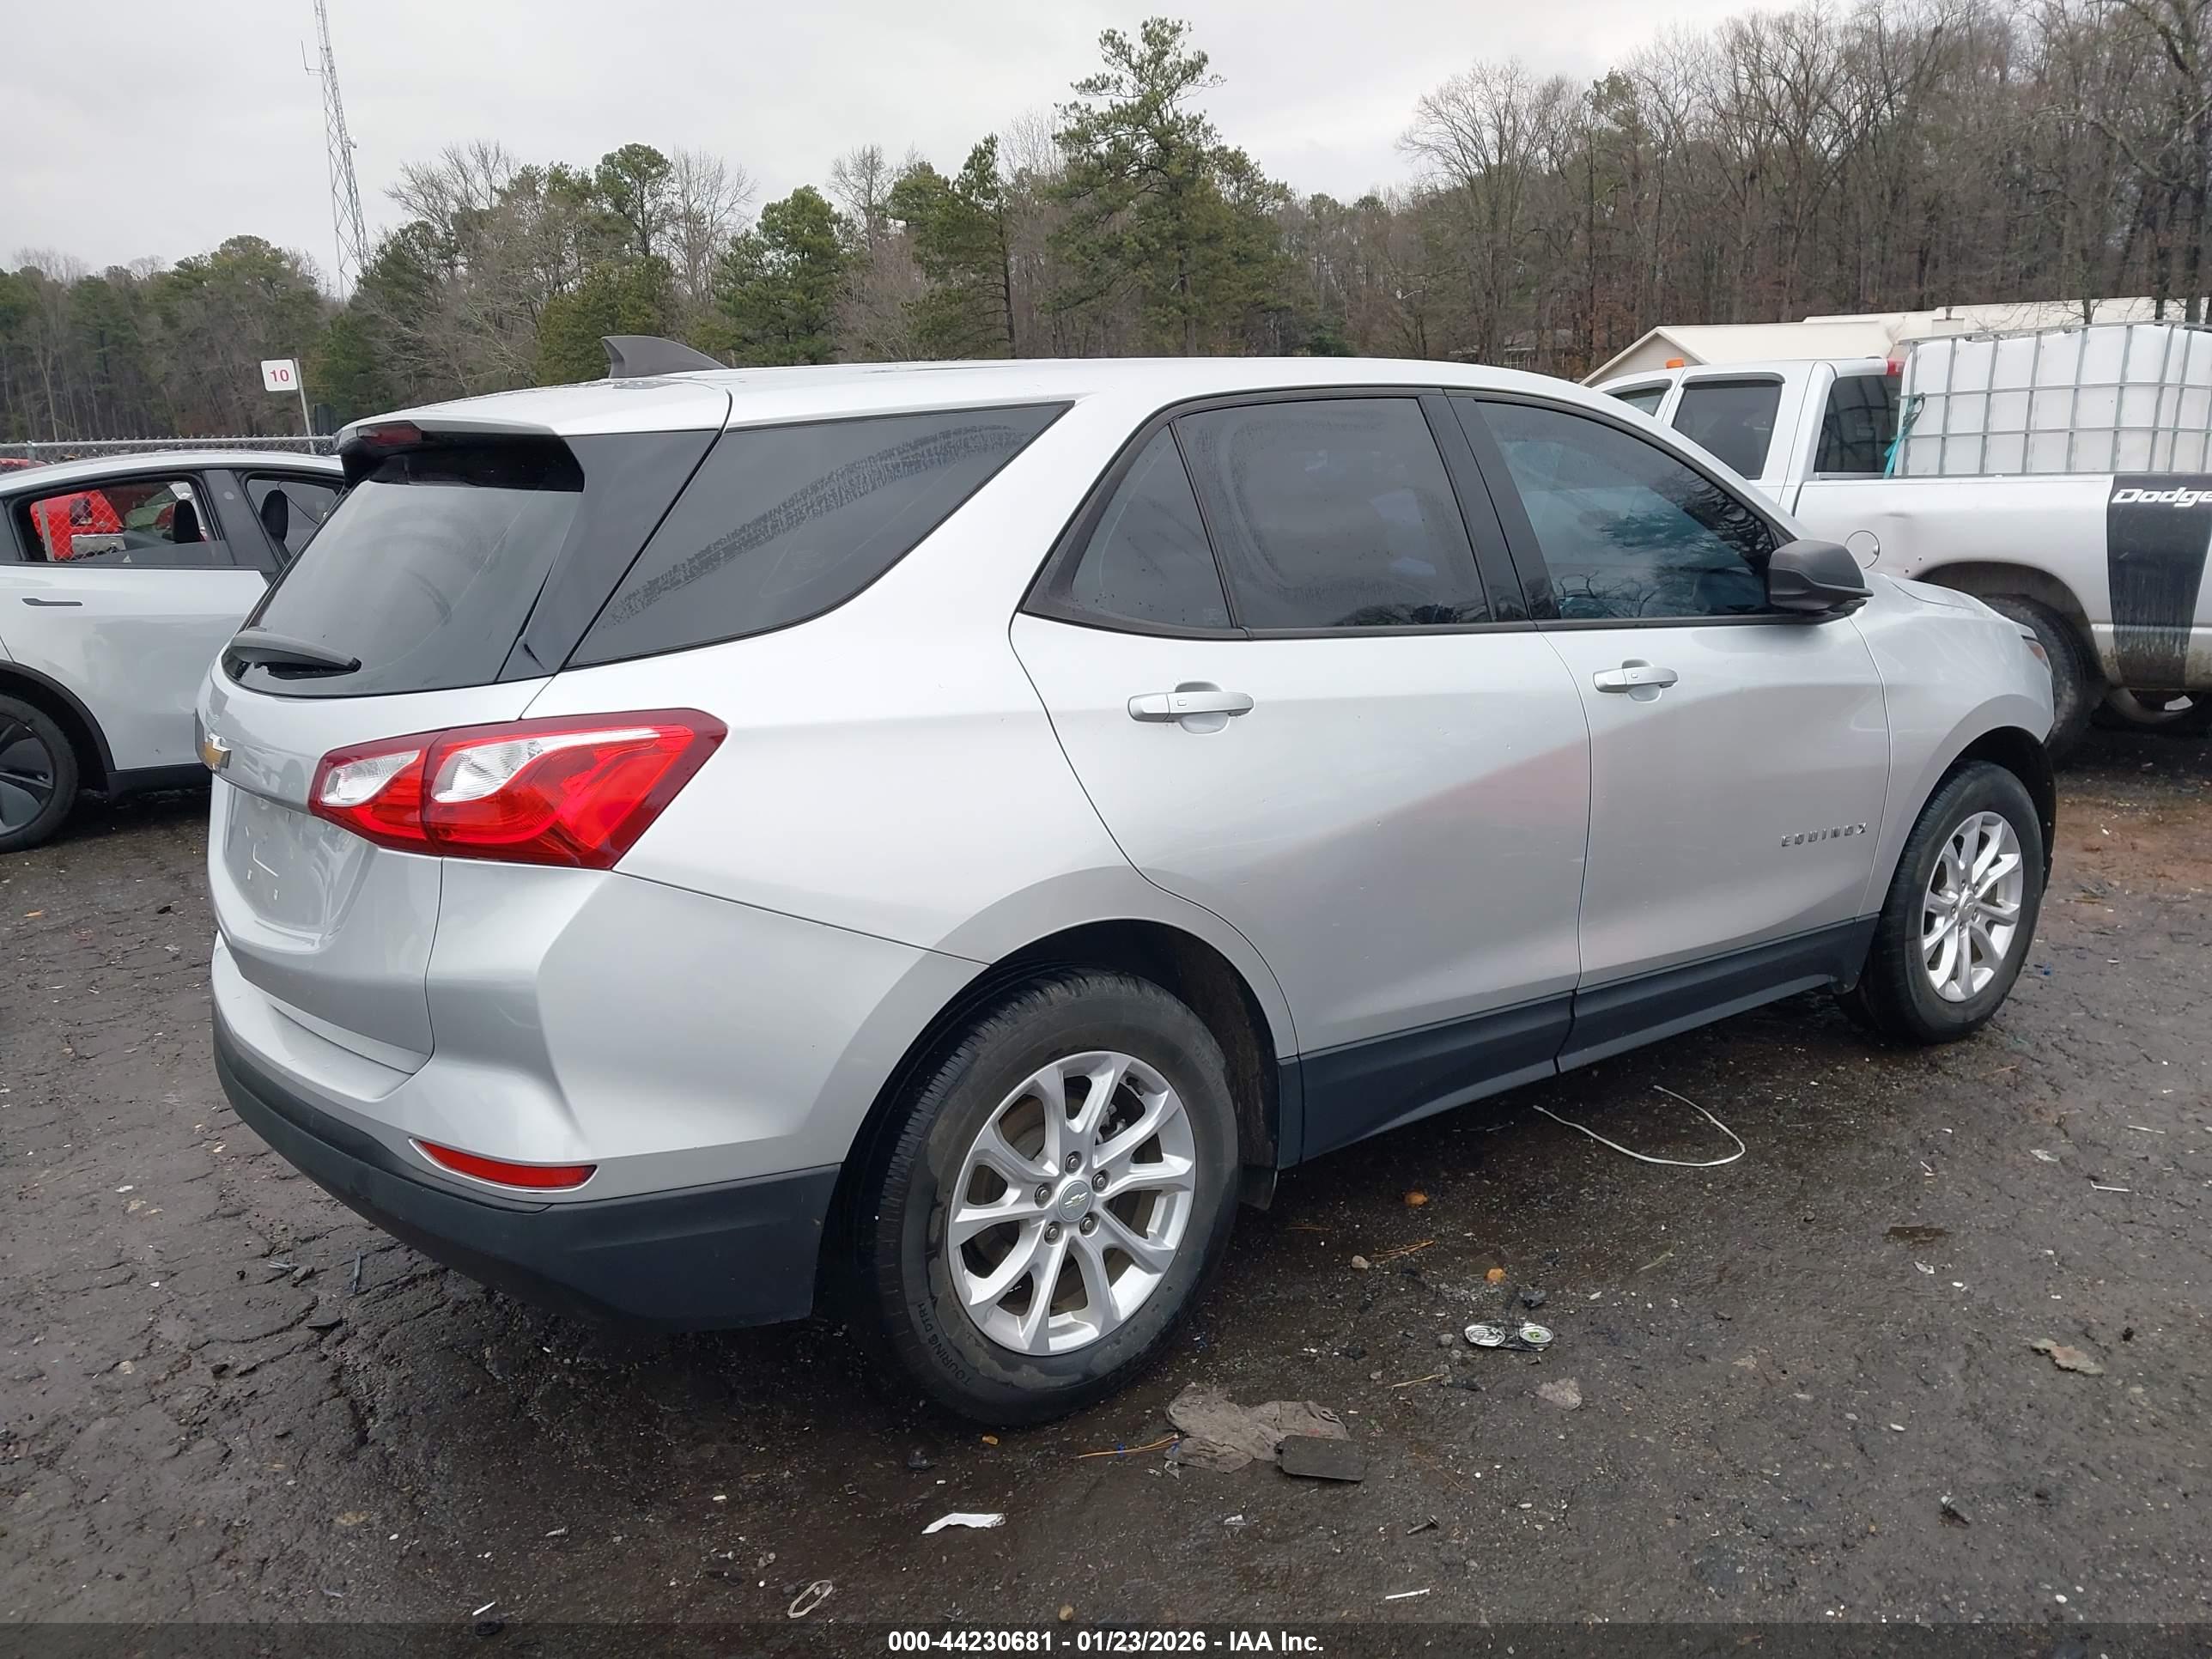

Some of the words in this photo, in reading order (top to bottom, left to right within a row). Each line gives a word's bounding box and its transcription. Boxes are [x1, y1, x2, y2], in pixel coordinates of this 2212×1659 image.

[269, 369, 289, 383] 10
[2112, 486, 2212, 507] Dodge
[1781, 822, 1867, 848] EQUINOX
[928, 1333, 971, 1388] TOURING
